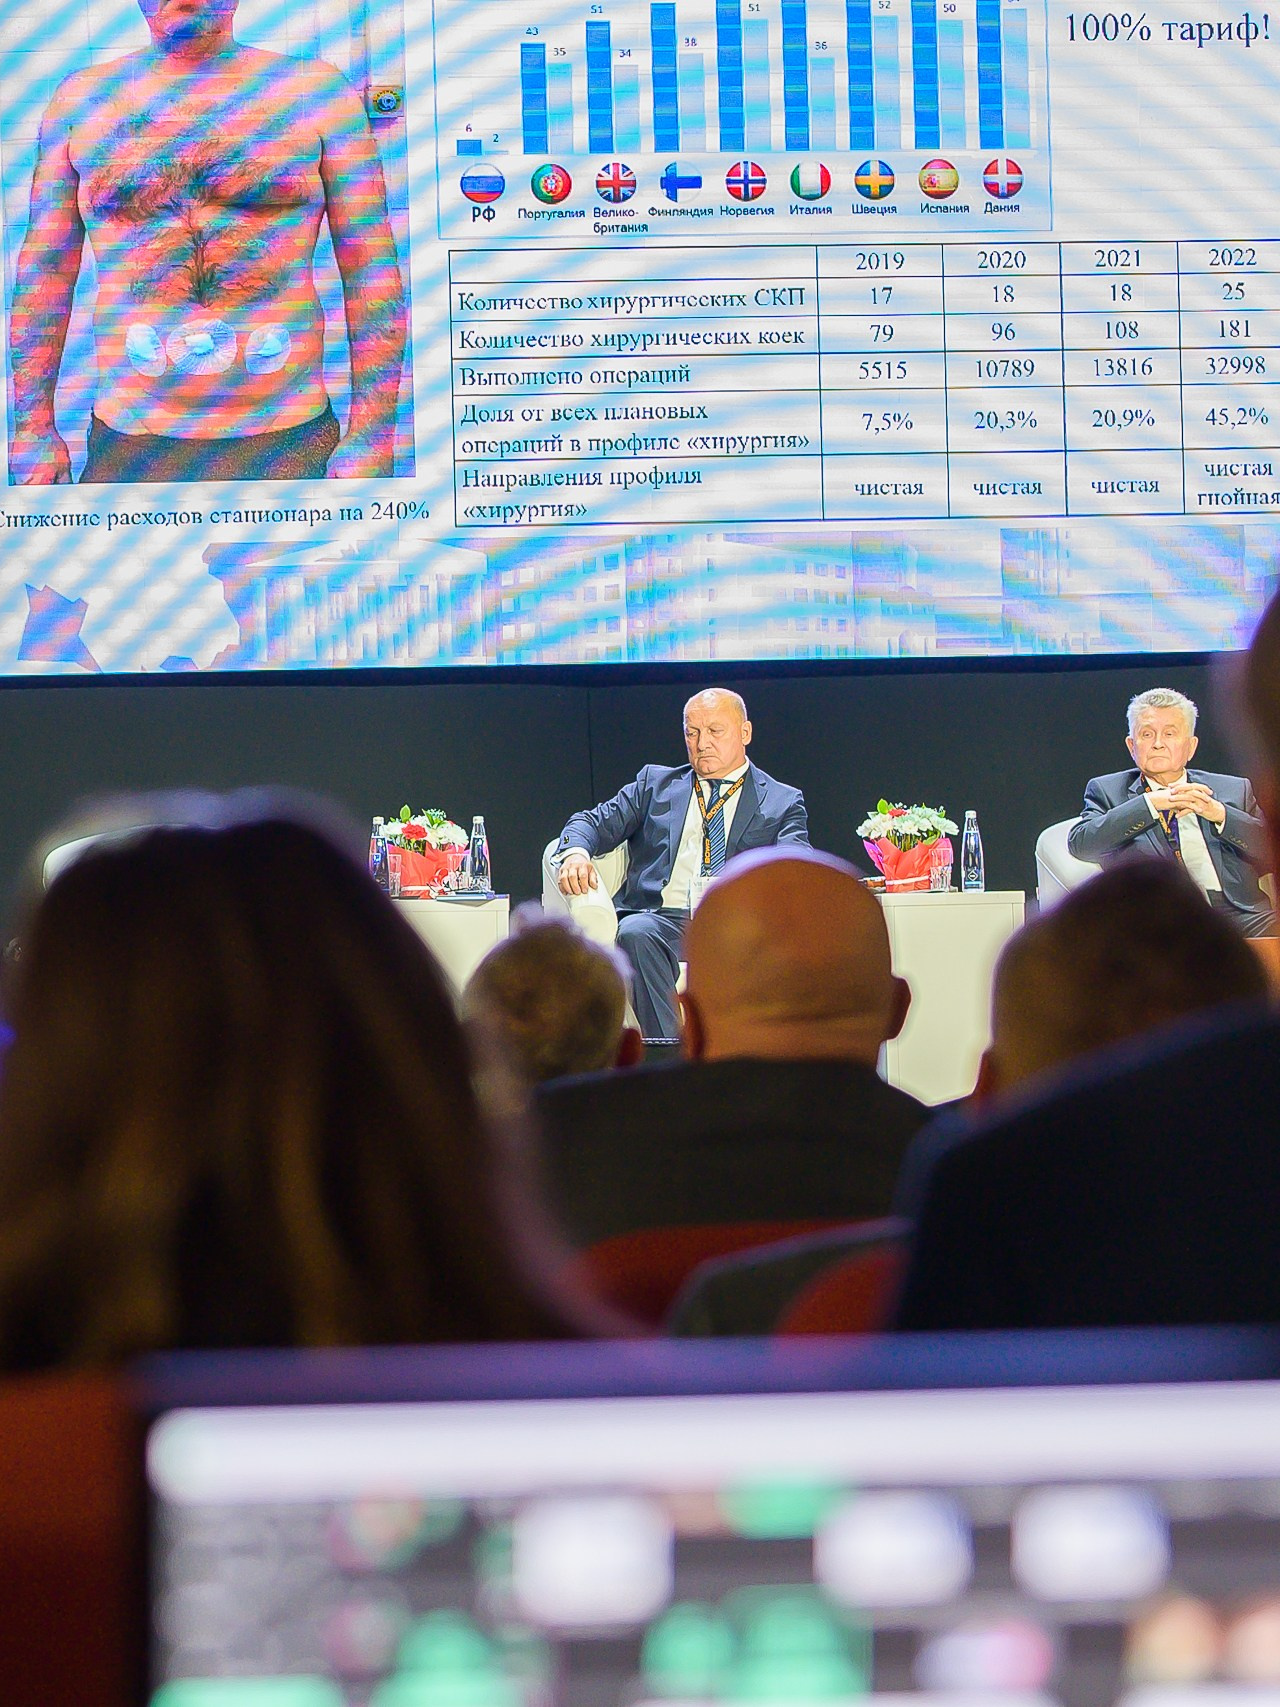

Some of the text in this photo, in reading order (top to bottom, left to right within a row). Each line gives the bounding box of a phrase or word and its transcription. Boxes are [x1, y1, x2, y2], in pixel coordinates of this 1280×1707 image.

[590, 4, 603, 14] 51
[748, 2, 760, 12] 51
[943, 3, 956, 13] 50
[1066, 12, 1270, 48] 100% тариф!
[553, 48, 566, 57] 35
[619, 48, 631, 58] 34
[472, 206, 496, 223] РФ
[518, 208, 586, 221] Португалия
[593, 206, 639, 218] Велико-
[648, 206, 714, 219] Финляндия
[720, 205, 775, 217] Норвегия
[790, 204, 833, 216] Италия
[852, 204, 898, 216] Швеция
[920, 203, 970, 215] Испания
[984, 203, 1020, 215] Дания
[593, 221, 649, 234] британия
[856, 251, 905, 271] 2019
[977, 250, 1026, 270] 2020
[1094, 249, 1142, 268] 2021
[1208, 248, 1258, 267] 2022
[458, 287, 806, 314] Количество хирургических СКП
[871, 286, 893, 305] 17
[992, 284, 1015, 304] 18
[1111, 283, 1132, 302] 18
[1222, 282, 1246, 302] 25
[870, 324, 894, 343] 79
[991, 322, 1016, 341] 96
[1105, 320, 1140, 339] 108
[1219, 319, 1251, 338] 181
[458, 330, 805, 352] Количество хирургических коек
[858, 360, 908, 380] 5515
[976, 359, 1035, 379] 10789
[1093, 358, 1154, 377] 13816
[1205, 356, 1266, 376] 32998
[460, 364, 692, 388] Выполнено операций
[460, 404, 708, 426] Доля от всех плановых
[861, 412, 914, 436] 7,5%
[974, 410, 1038, 434] 20,3%
[1092, 408, 1156, 432] 20,9%
[1204, 407, 1270, 430] 45,2%
[462, 433, 810, 458] операций в профиле «хирургия»
[463, 466, 702, 492] Направления профиля
[1204, 462, 1273, 478] чистая
[854, 482, 924, 496] чистая
[972, 480, 1043, 496] чистая
[1091, 478, 1160, 494] чистая
[1197, 488, 1280, 505] гнойная
[106, 510, 203, 531] расходов
[210, 506, 332, 527] стационара
[339, 508, 364, 522] на
[370, 502, 430, 522] 240%
[463, 504, 588, 524] «хирургия»
